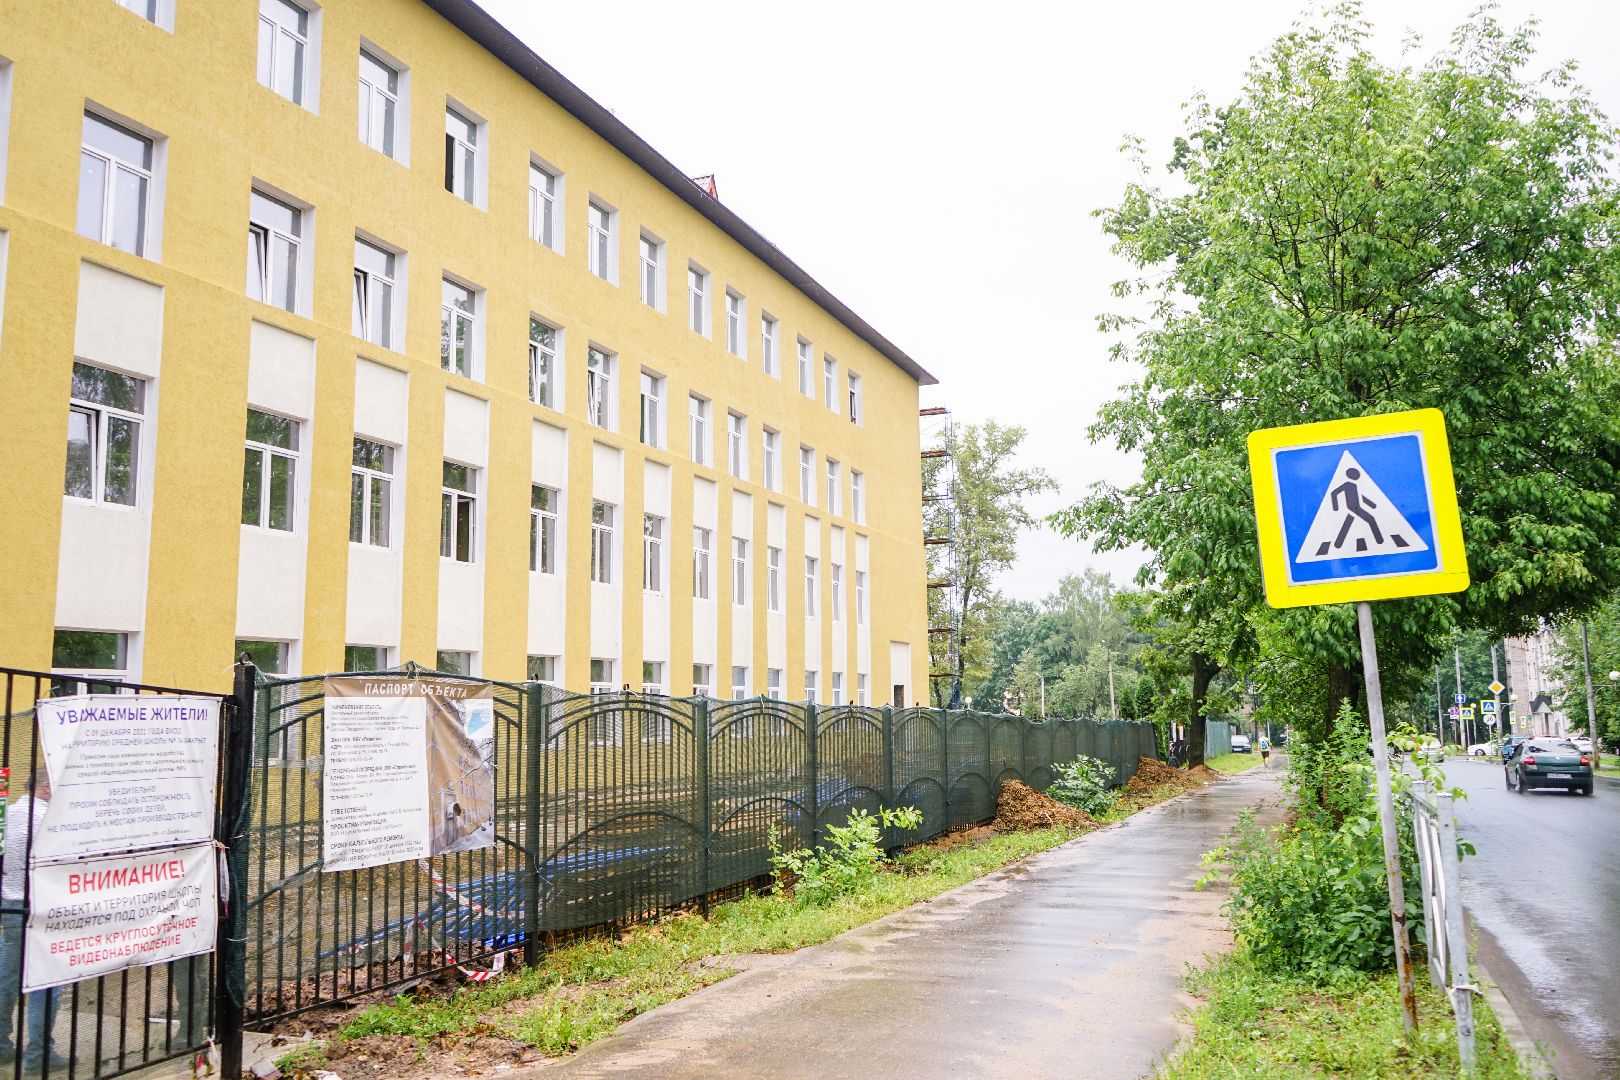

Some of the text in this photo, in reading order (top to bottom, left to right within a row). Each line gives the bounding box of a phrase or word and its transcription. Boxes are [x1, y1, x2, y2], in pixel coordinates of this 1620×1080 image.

[364, 683, 467, 698] ПАСПОРТ ОБЪЕКТА
[150, 707, 208, 721] ЖИТЕЛИ!
[100, 728, 132, 737] ДЕКАБРЯ
[69, 800, 98, 810] ПРОСИМ
[47, 825, 58, 833] НЕ
[68, 860, 185, 895] ВНИМАНИЕ!
[47, 884, 202, 920] ОБЪЕКТ И ТЕРРИТОРИЯ ШКОЛЫ
[45, 897, 201, 933] НАХОДЯТСЯ ПОД ОХРАНОЙ ЧОП
[50, 918, 198, 954] ВЕДЕТСЯ КРУГЛОСУТОЧНОЕ
[68, 934, 182, 967] ВИДЕОНАБЛЮДЕНИЕ
